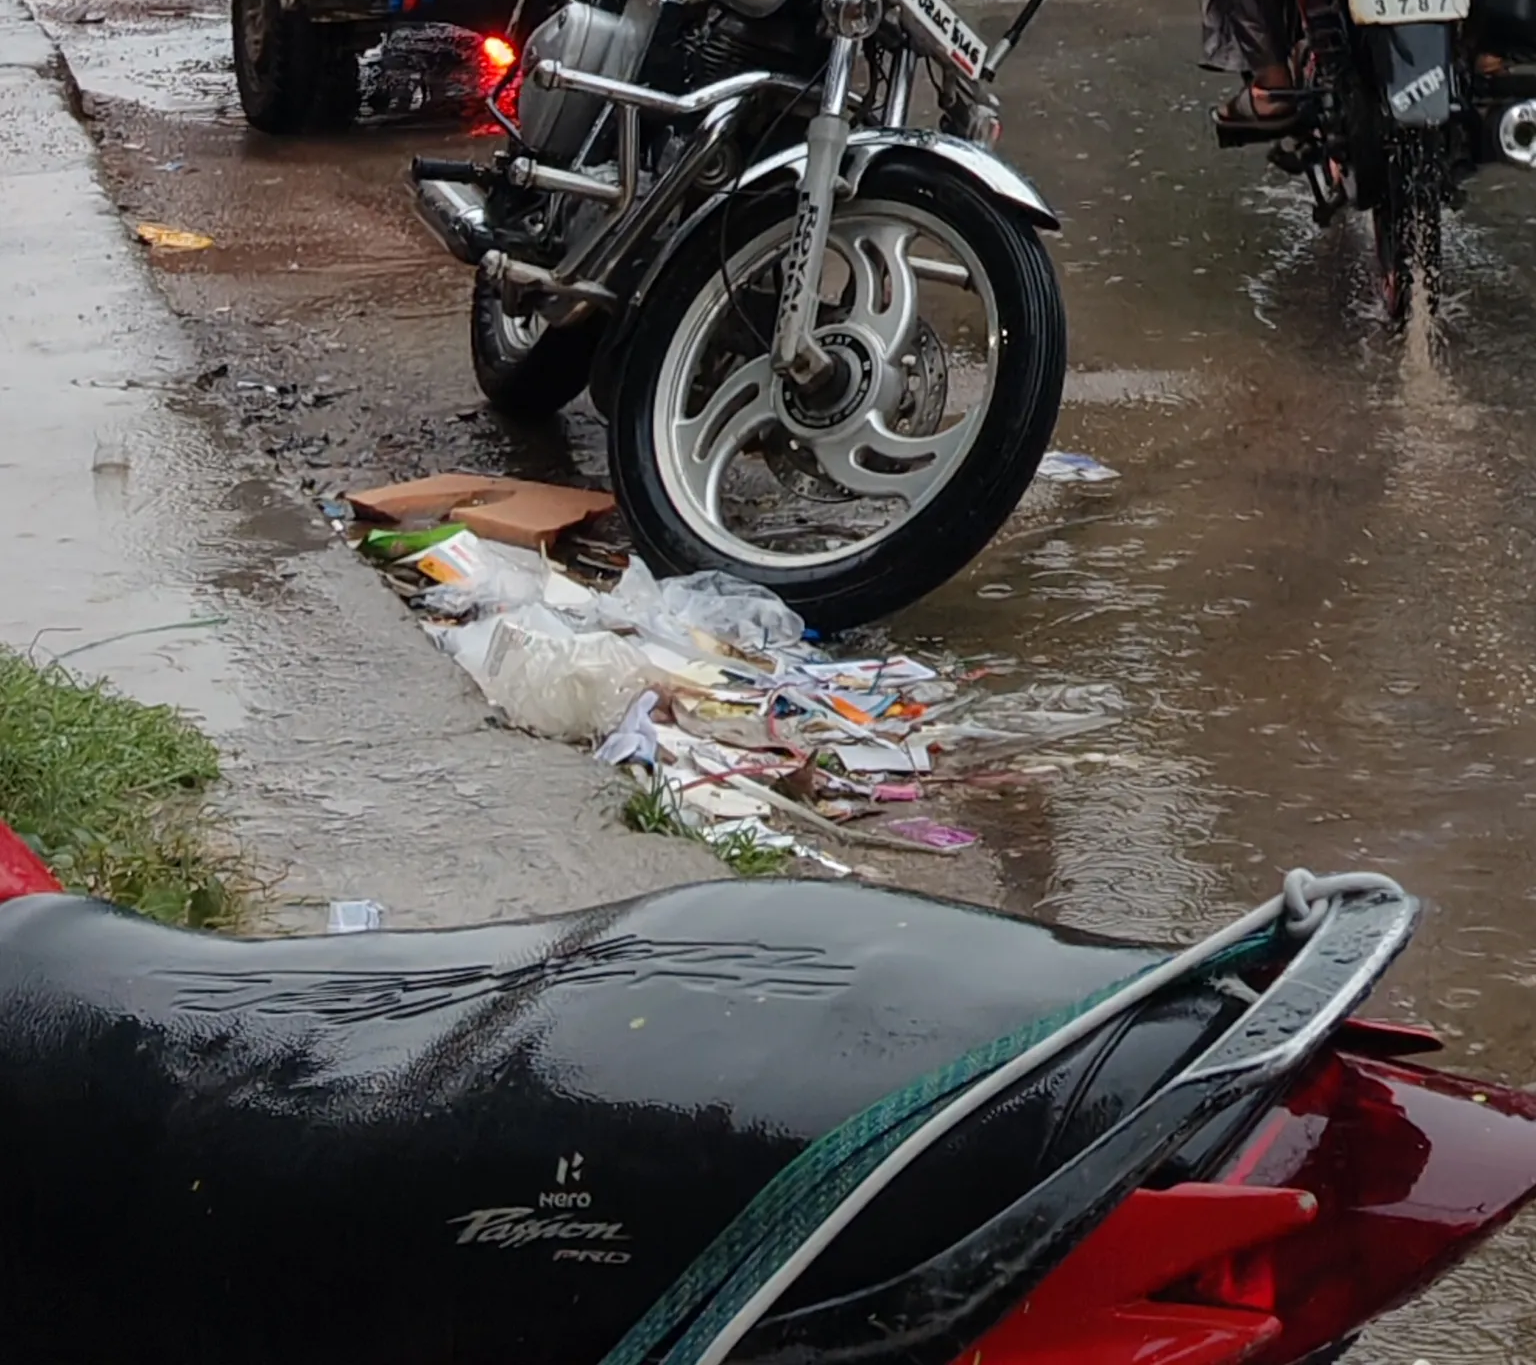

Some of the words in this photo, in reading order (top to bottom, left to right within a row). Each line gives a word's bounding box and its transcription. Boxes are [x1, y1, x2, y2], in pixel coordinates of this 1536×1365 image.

[1391, 64, 1447, 113] STOP
[446, 1206, 634, 1250] Passion
[552, 1248, 632, 1264] PRO
